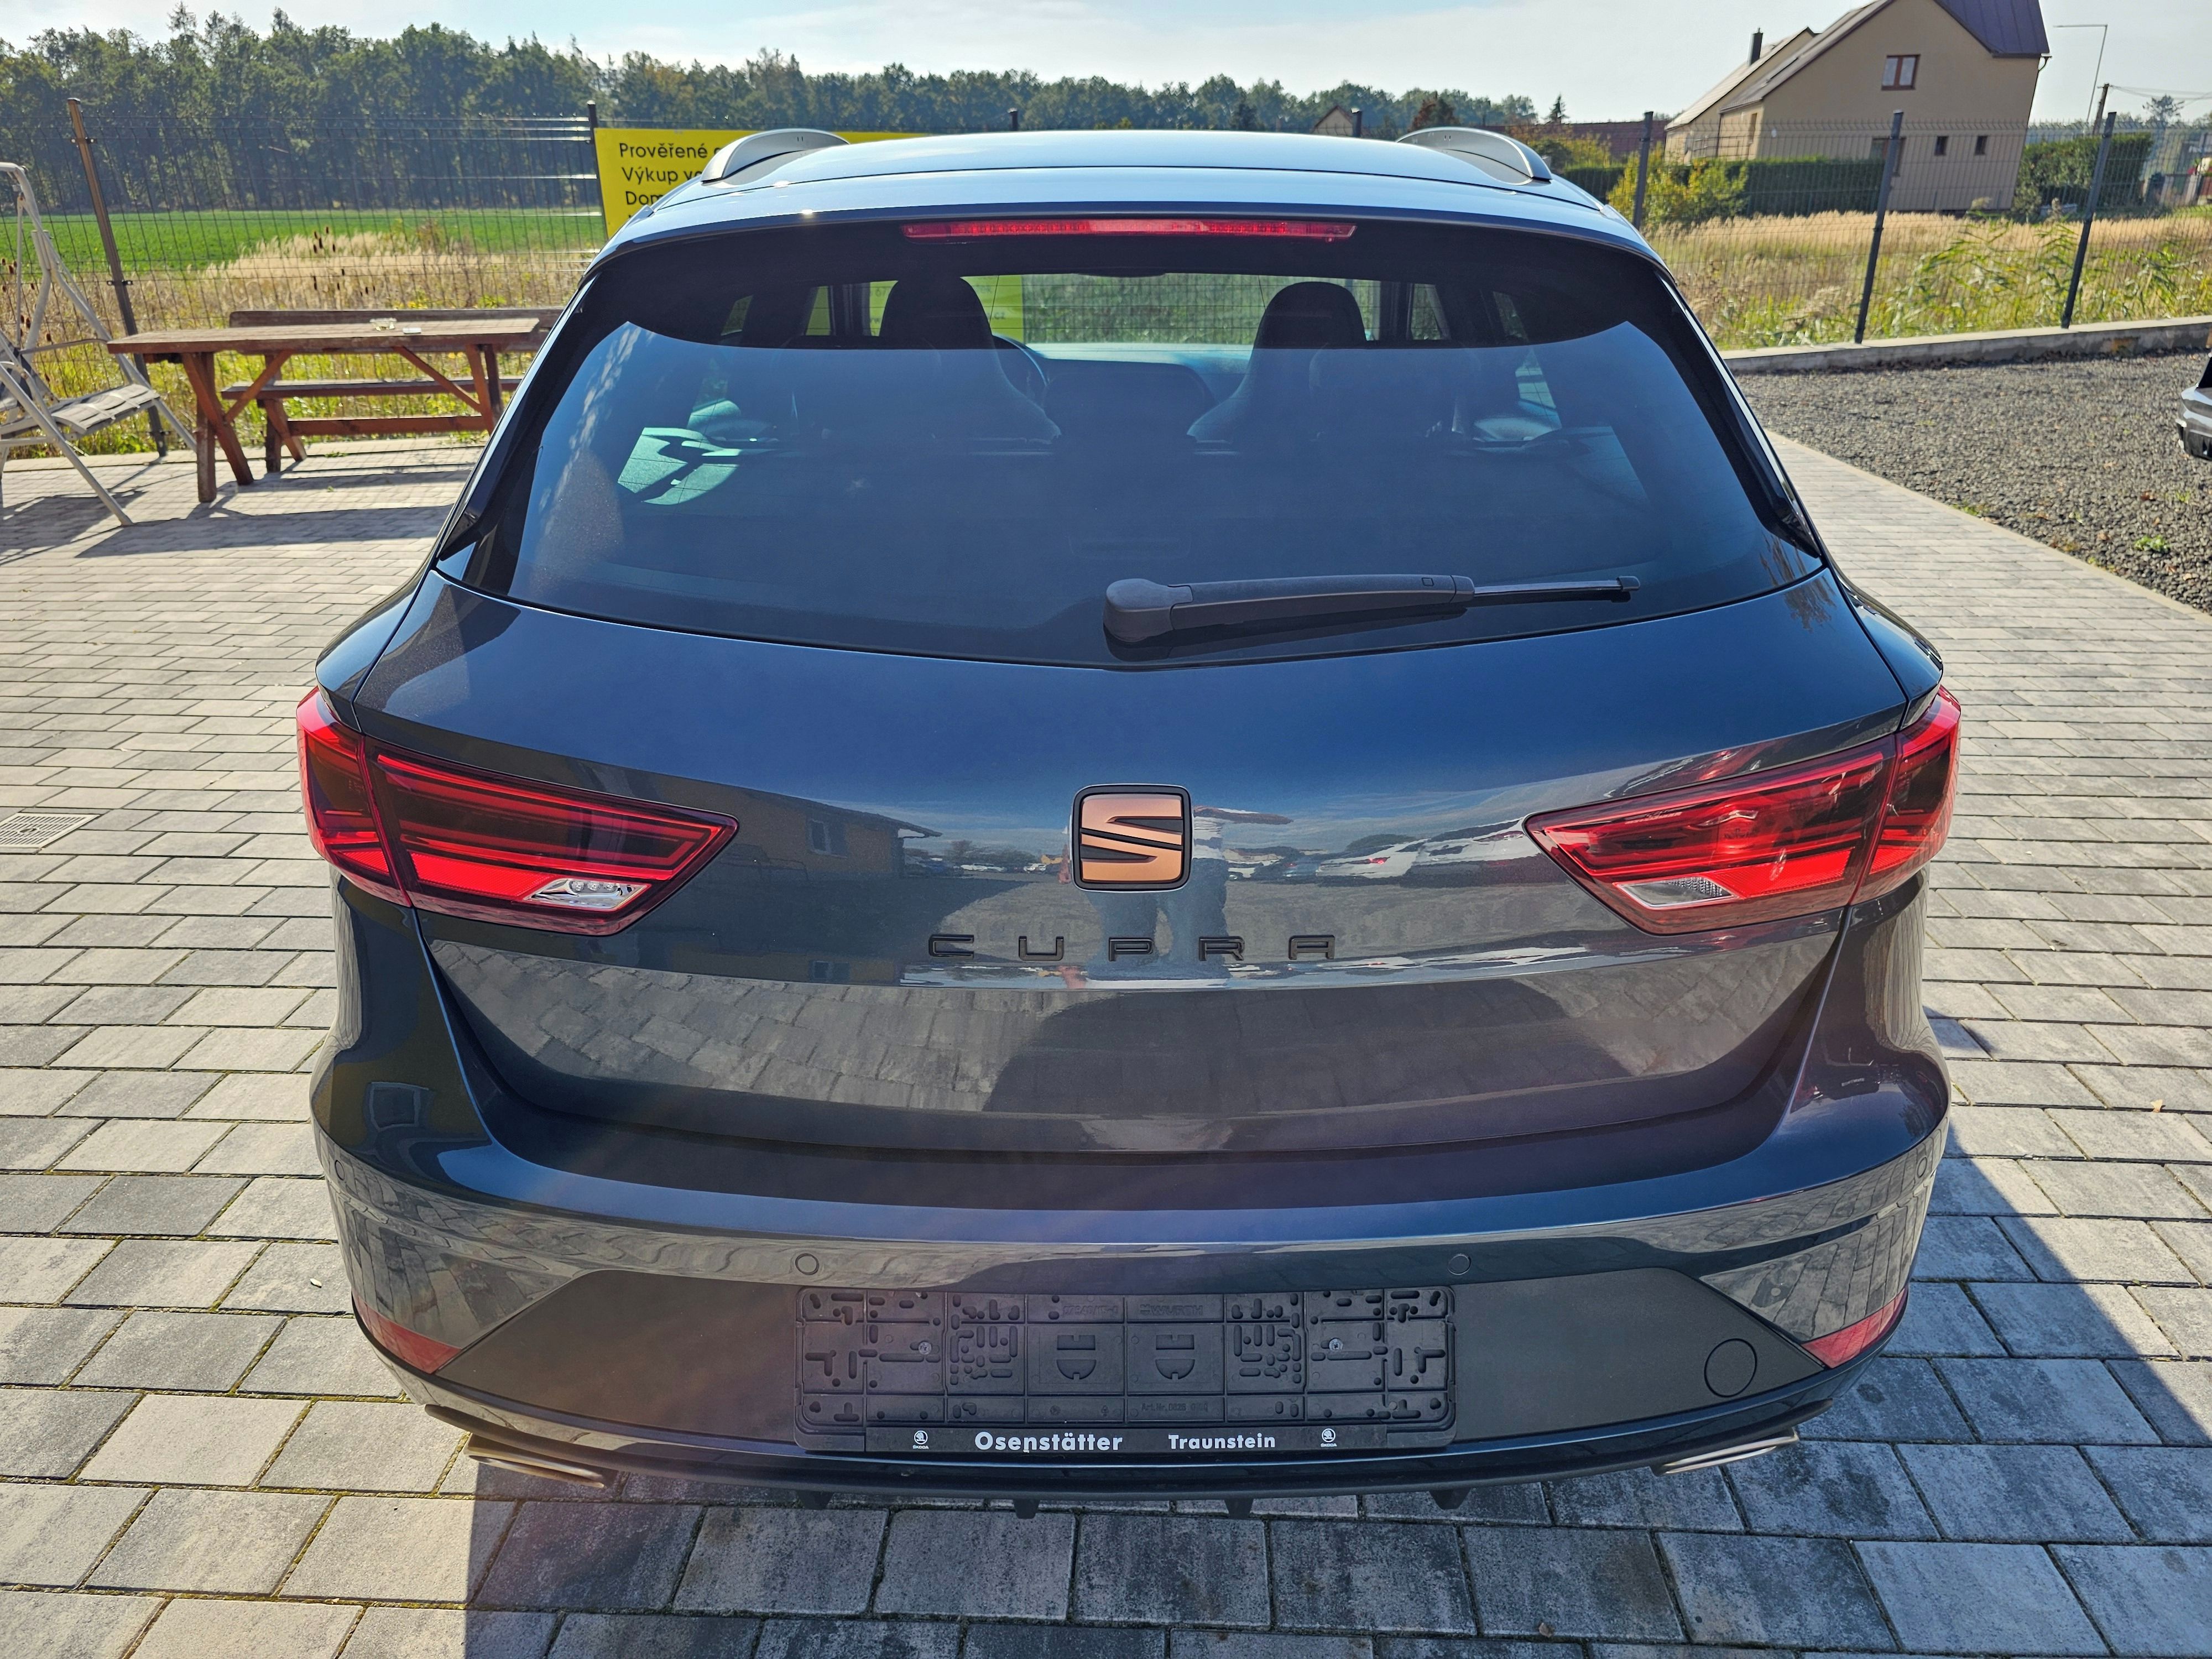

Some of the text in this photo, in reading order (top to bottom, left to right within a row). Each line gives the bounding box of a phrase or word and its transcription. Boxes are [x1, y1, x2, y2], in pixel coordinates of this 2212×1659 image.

[619, 142, 707, 158] Prověřené
[621, 166, 678, 185] Výkup
[928, 933, 1335, 962] CUPRA
[975, 1431, 1275, 1451] Osenstätter Traunstein
